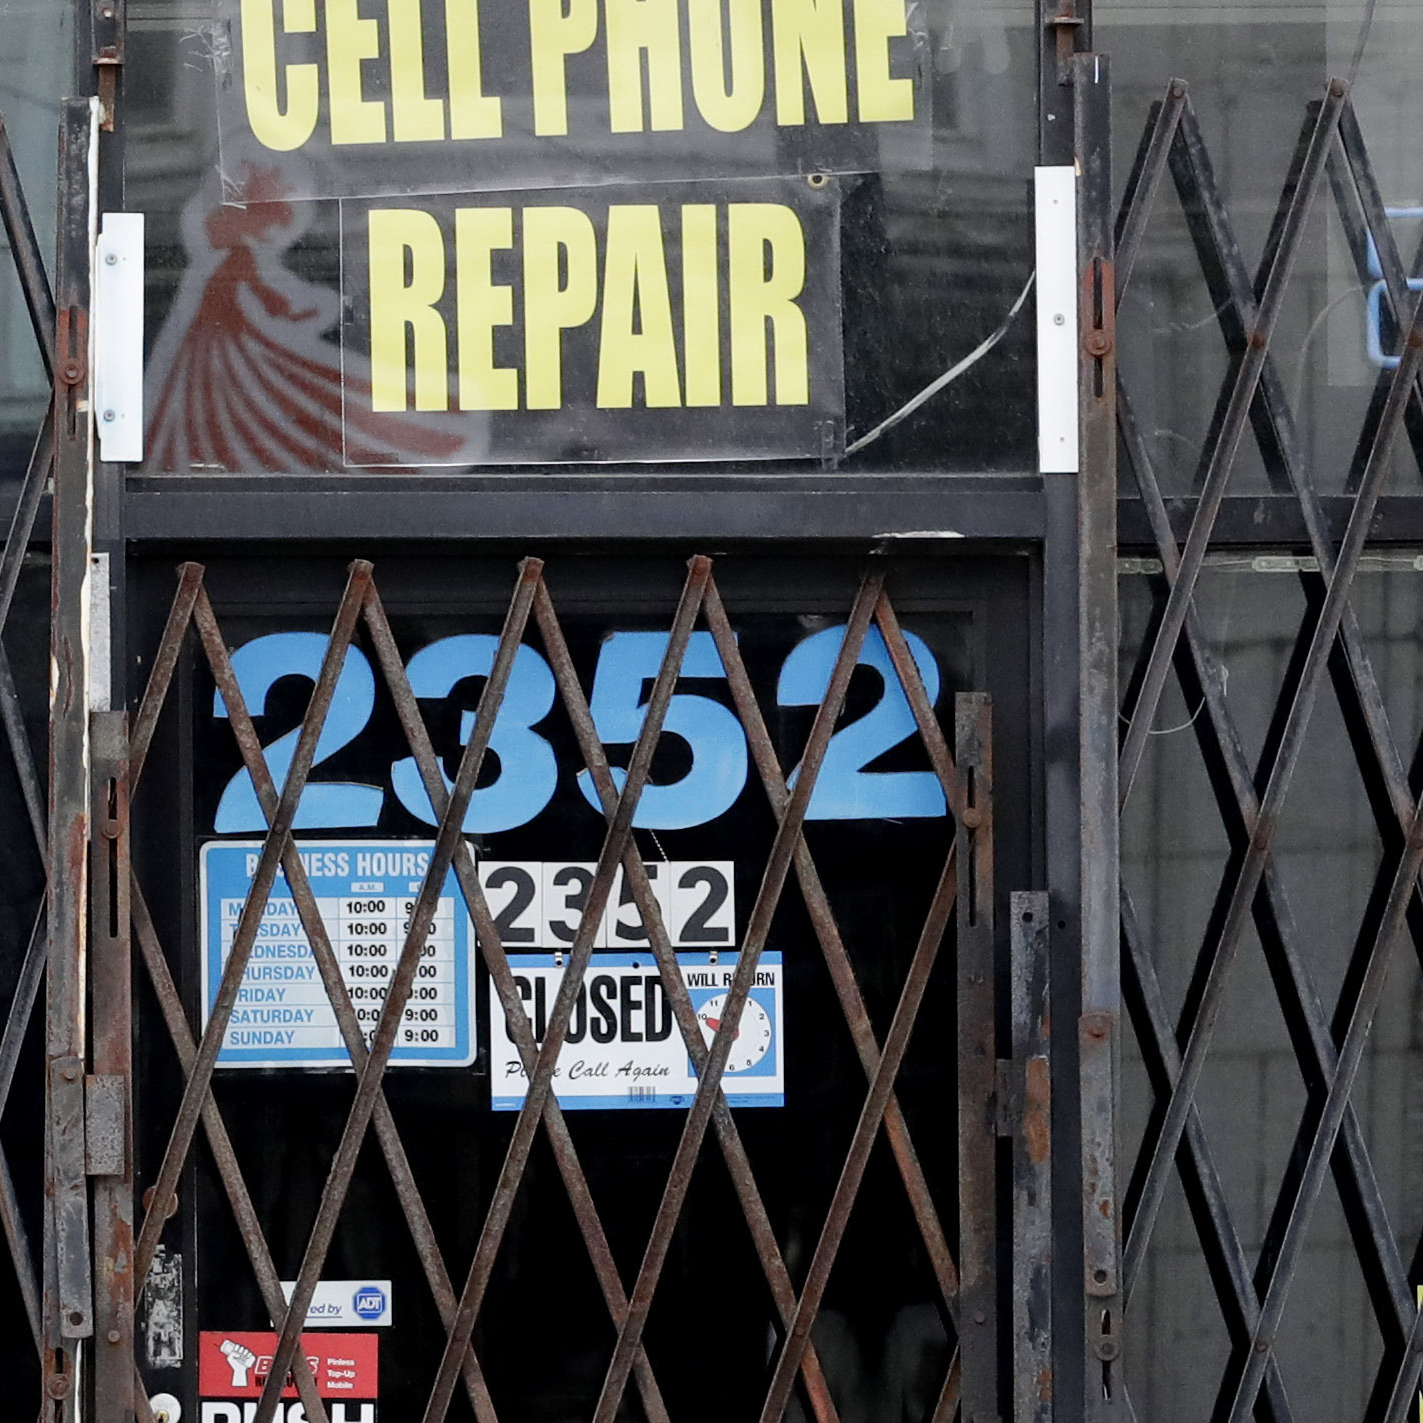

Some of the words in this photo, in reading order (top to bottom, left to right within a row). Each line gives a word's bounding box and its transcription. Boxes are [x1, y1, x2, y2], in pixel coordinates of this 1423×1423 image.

[241, 0, 503, 152] CELL
[535, 0, 916, 140] PHONE
[366, 200, 811, 413] REPAIR
[211, 625, 948, 836] 2352
[346, 900, 386, 914] 10:00
[482, 866, 731, 944] 2352
[347, 923, 387, 935] 10:00
[347, 944, 387, 957] 10:00
[348, 965, 389, 978] 10:00
[687, 973, 719, 987] WILL
[230, 1009, 314, 1025] SATURDAY
[404, 1008, 438, 1021] 9:00
[504, 974, 673, 1044] CLOSED
[230, 1031, 295, 1045] SUNDAY
[404, 1029, 439, 1042] 9:00
[568, 1060, 609, 1080] Call
[614, 1059, 671, 1085] Again
[358, 1296, 383, 1310] ADT
